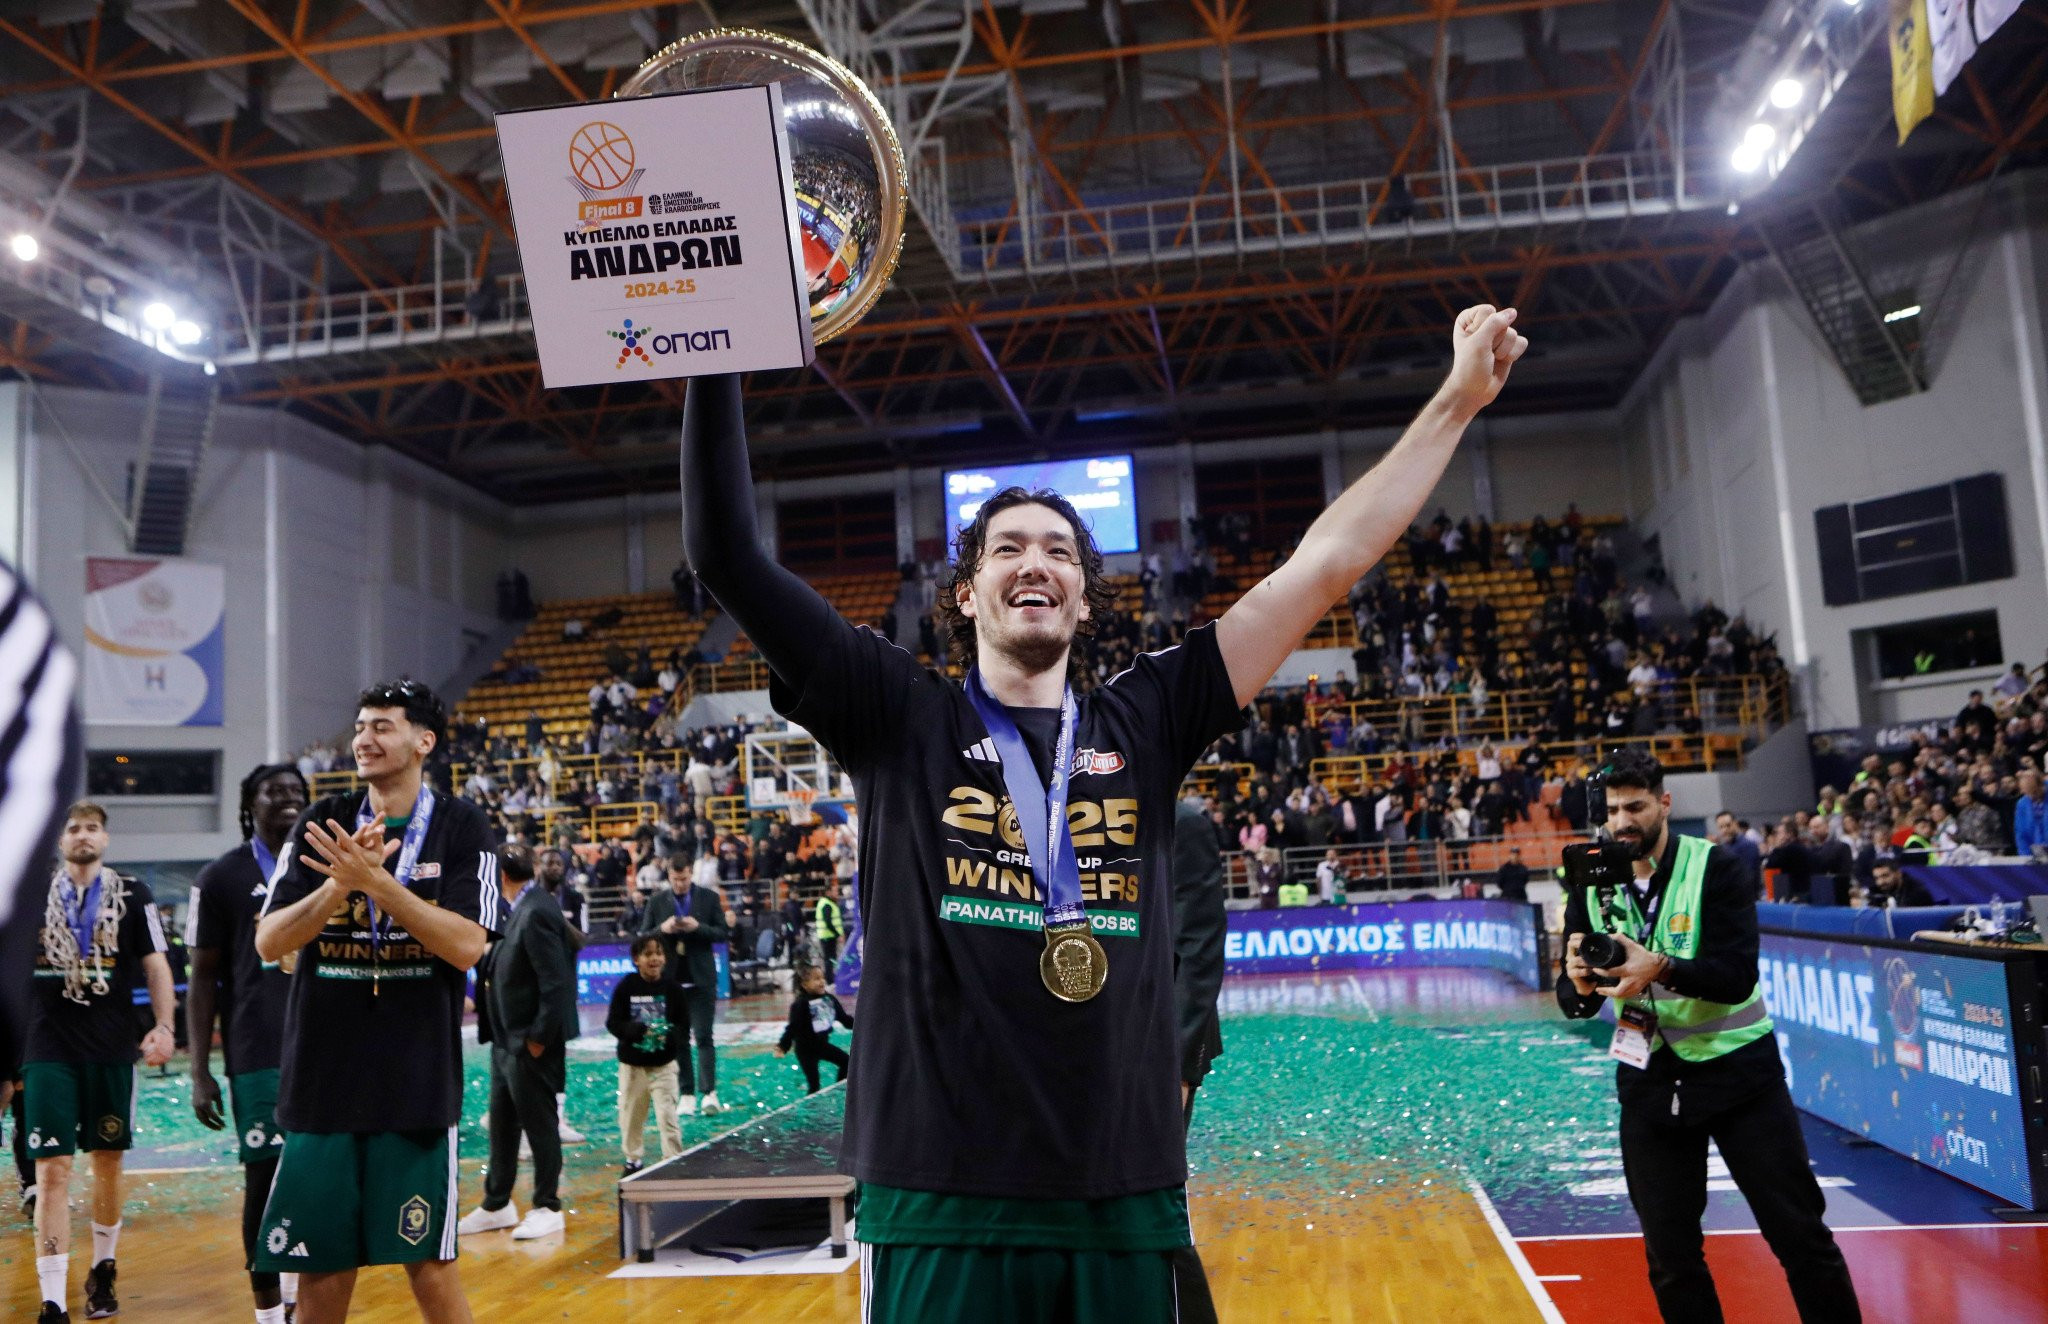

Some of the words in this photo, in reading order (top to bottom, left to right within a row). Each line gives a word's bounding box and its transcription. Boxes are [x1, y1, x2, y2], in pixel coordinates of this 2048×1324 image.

[585, 203, 622, 219] Final
[625, 201, 635, 214] 8
[564, 224, 650, 246] ΚΥΠΕΛΛΟ
[653, 215, 737, 237] ΕΛΛΑΔΑΣ
[570, 234, 743, 280] ΑΝΔΡΩΝ
[624, 278, 697, 299] 2024-25
[996, 849, 1032, 868] GRE
[1077, 857, 1102, 869] UP
[946, 901, 1118, 931] PANATHIOS
[1119, 916, 1137, 932] BC
[318, 941, 435, 960] WINNER
[415, 967, 432, 976] BC
[1758, 958, 1879, 1044] ΕΛΛΑΔΑΣ
